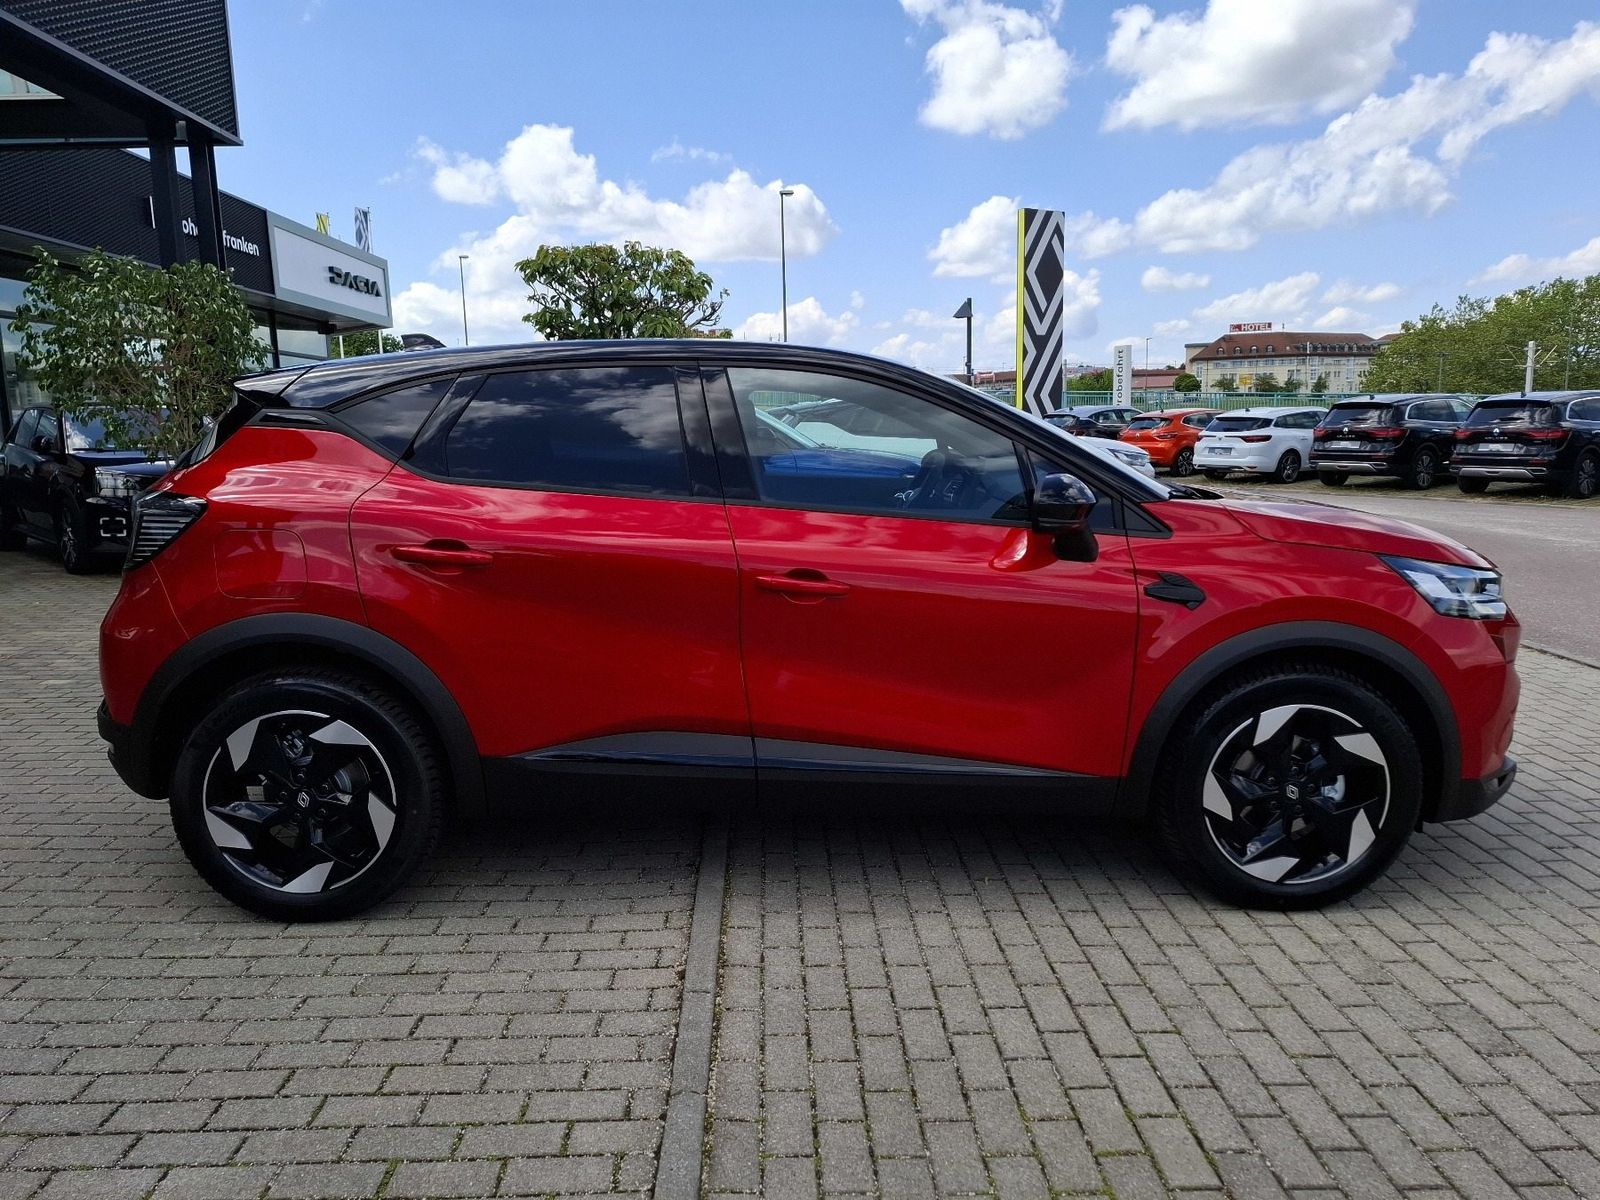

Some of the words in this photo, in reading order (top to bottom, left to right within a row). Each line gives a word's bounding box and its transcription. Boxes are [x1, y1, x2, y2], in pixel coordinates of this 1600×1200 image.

[222, 230, 259, 257] franken
[328, 265, 383, 297] DACIA
[1241, 323, 1270, 331] HOTEL
[1116, 349, 1124, 406] robefahrt
